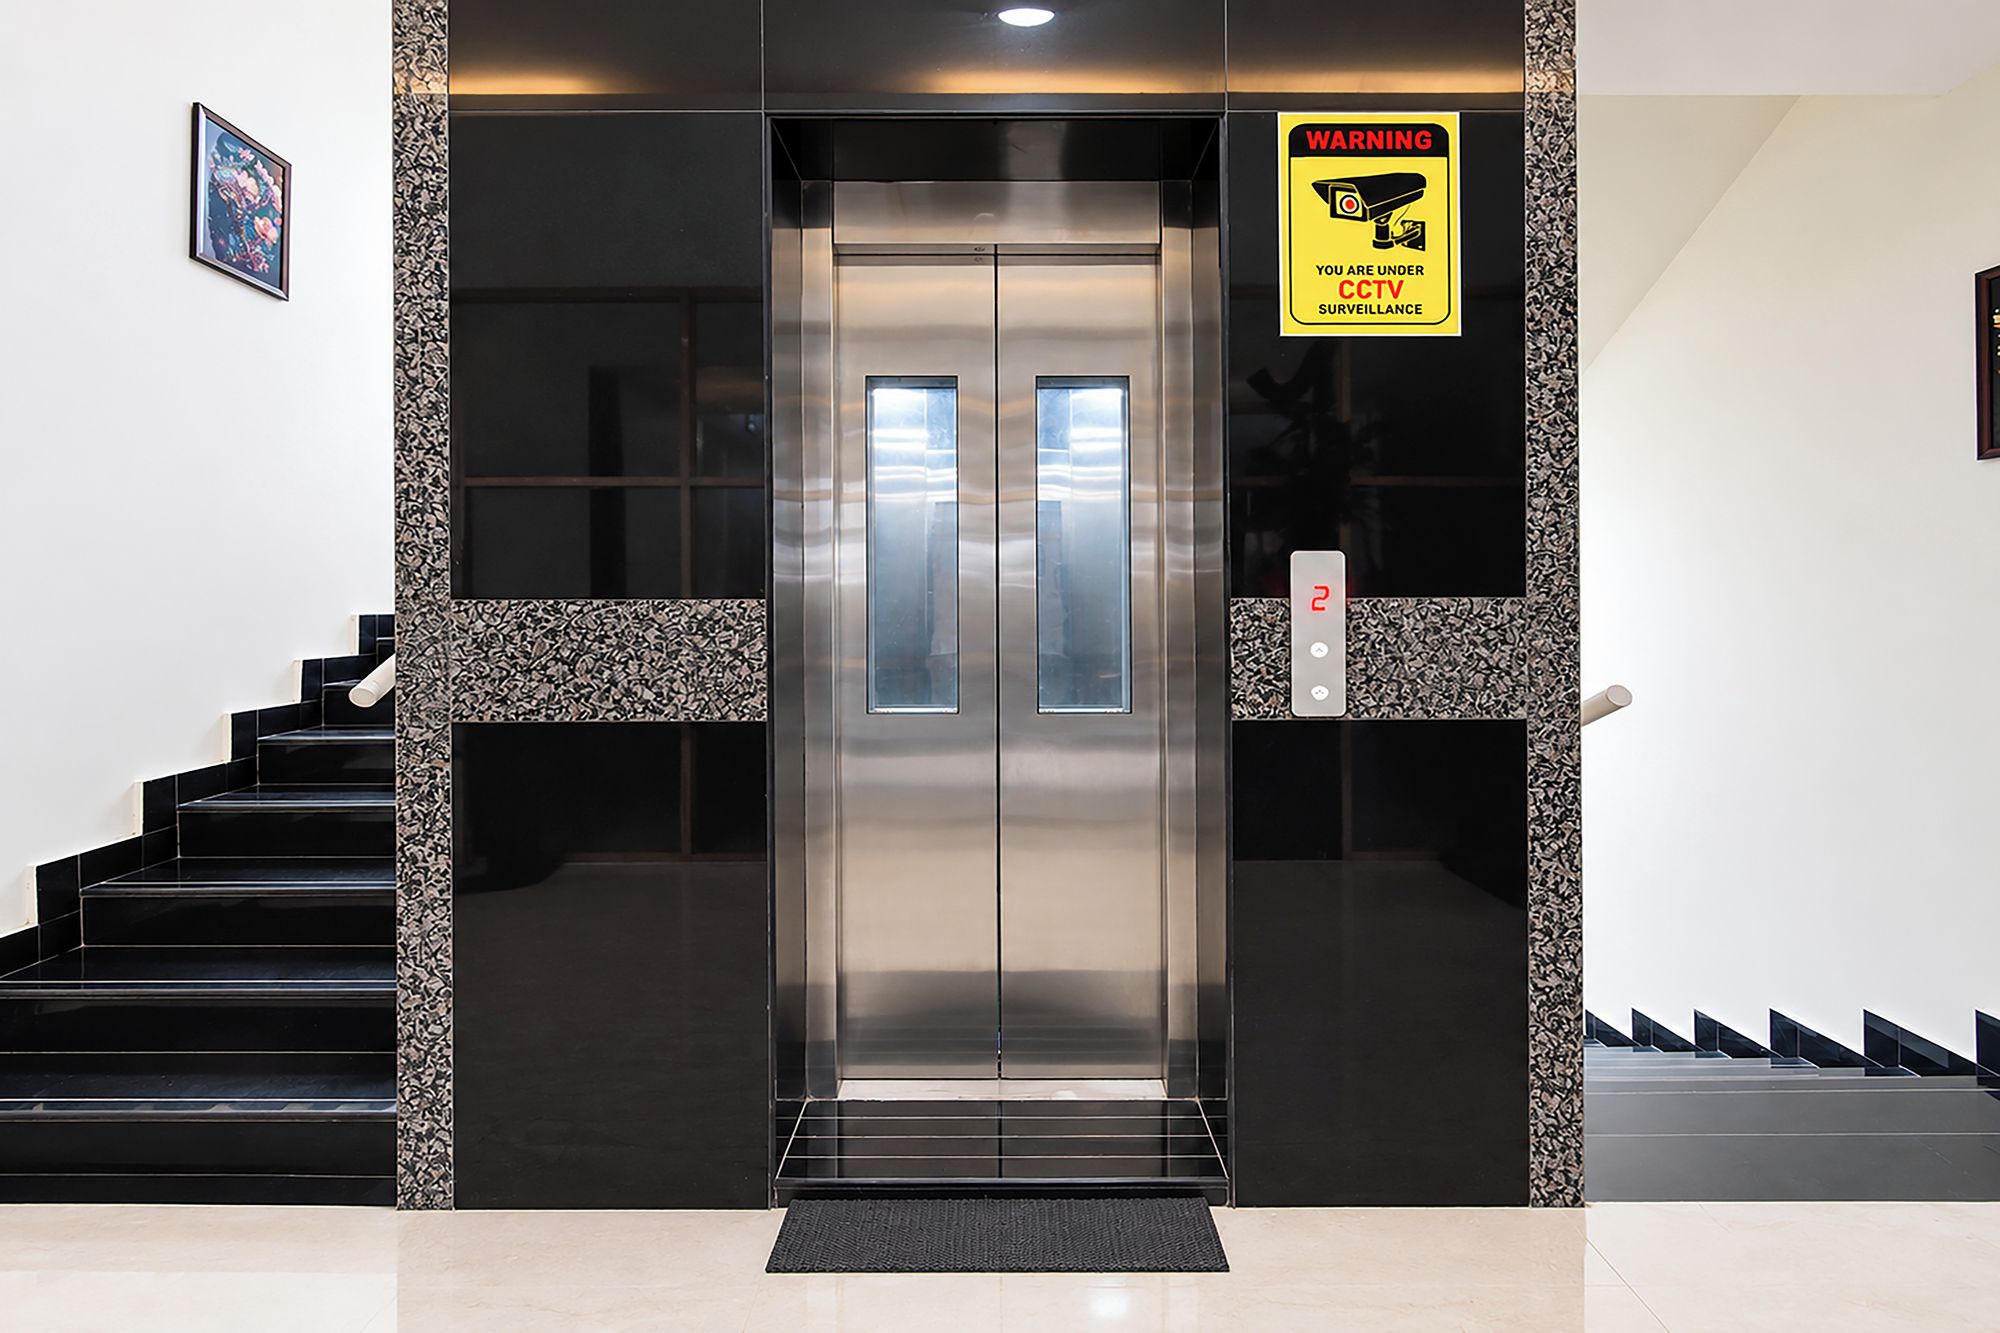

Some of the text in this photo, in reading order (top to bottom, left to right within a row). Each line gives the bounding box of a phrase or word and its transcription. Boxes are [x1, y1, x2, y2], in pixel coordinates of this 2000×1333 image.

[1306, 130, 1432, 150] WARNING
[1316, 265, 1424, 276] YOU ARE UNDER
[1338, 279, 1404, 299] CCTV
[1318, 303, 1423, 315] SURVEILLANCE
[1311, 585, 1330, 611] 2
